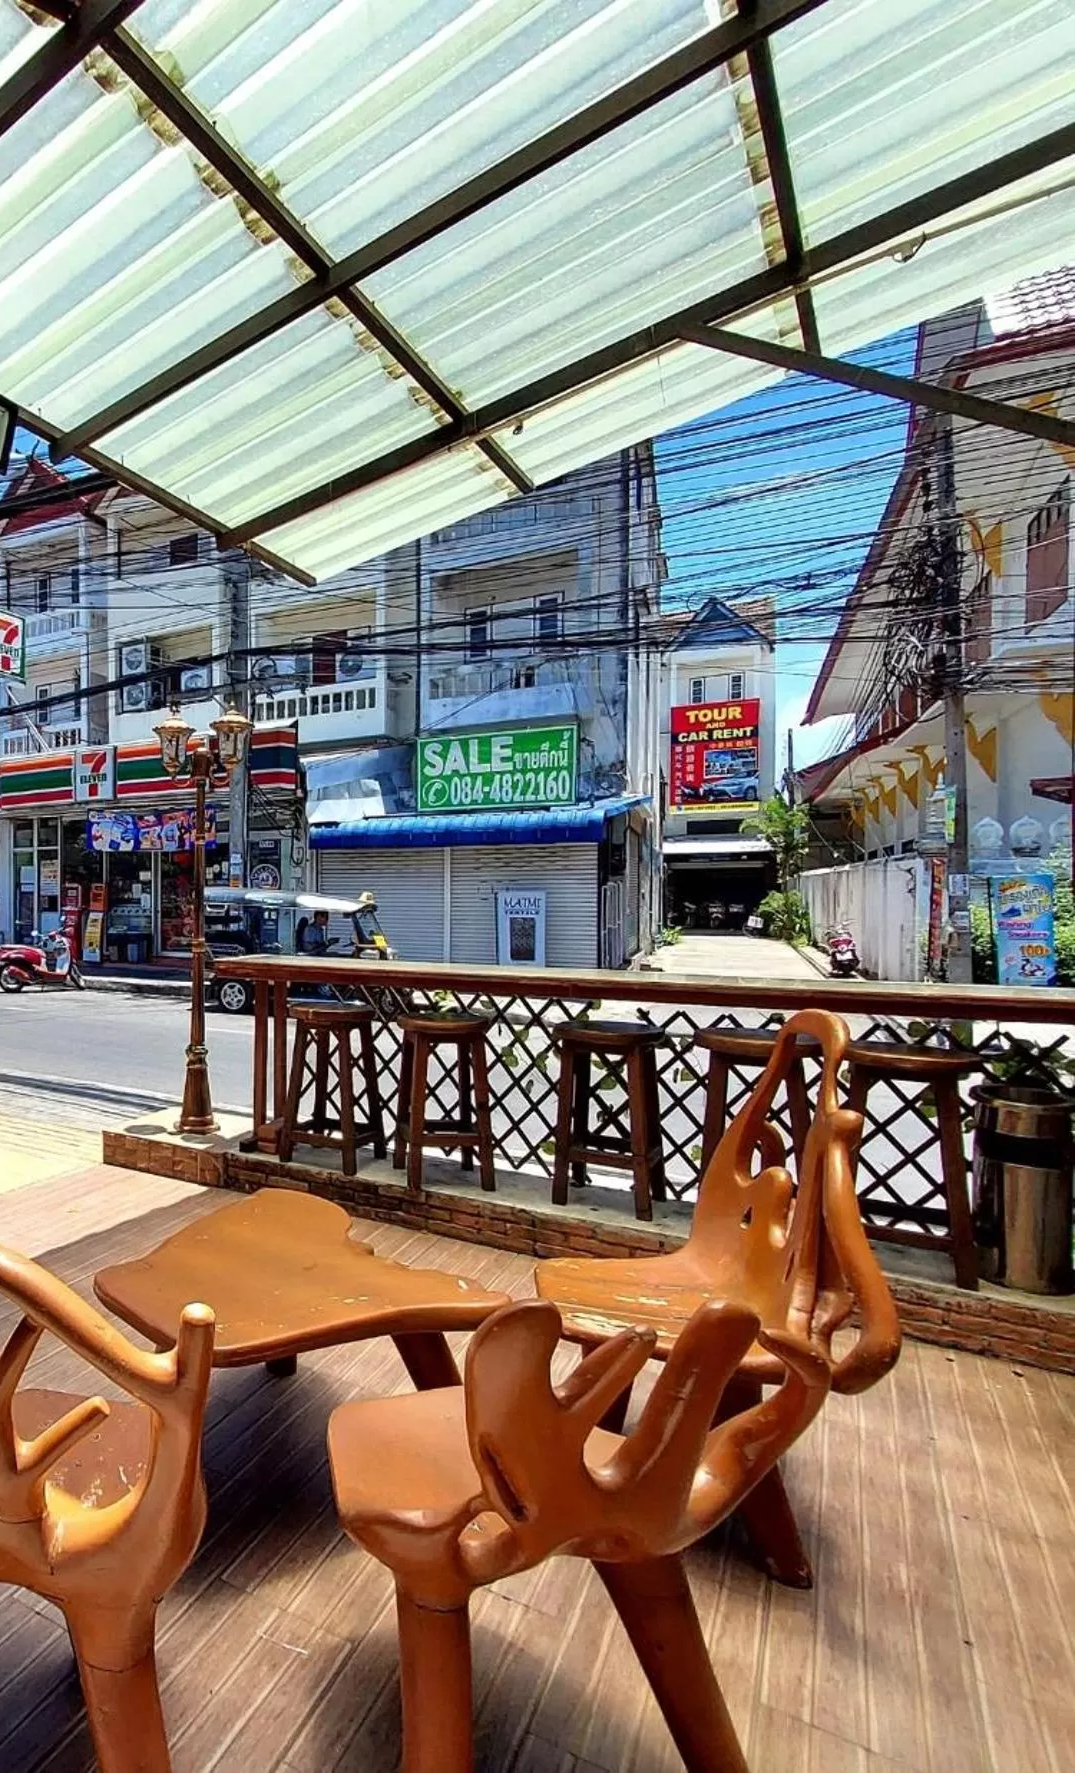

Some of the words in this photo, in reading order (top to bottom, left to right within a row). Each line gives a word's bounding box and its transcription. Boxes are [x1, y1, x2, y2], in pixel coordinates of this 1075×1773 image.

[685, 706, 742, 724] TOUR
[678, 730, 709, 742] CAR
[712, 726, 754, 739] RENT
[81, 751, 106, 797] 7
[423, 736, 514, 777] SALE
[450, 770, 571, 805] 084-4822160
